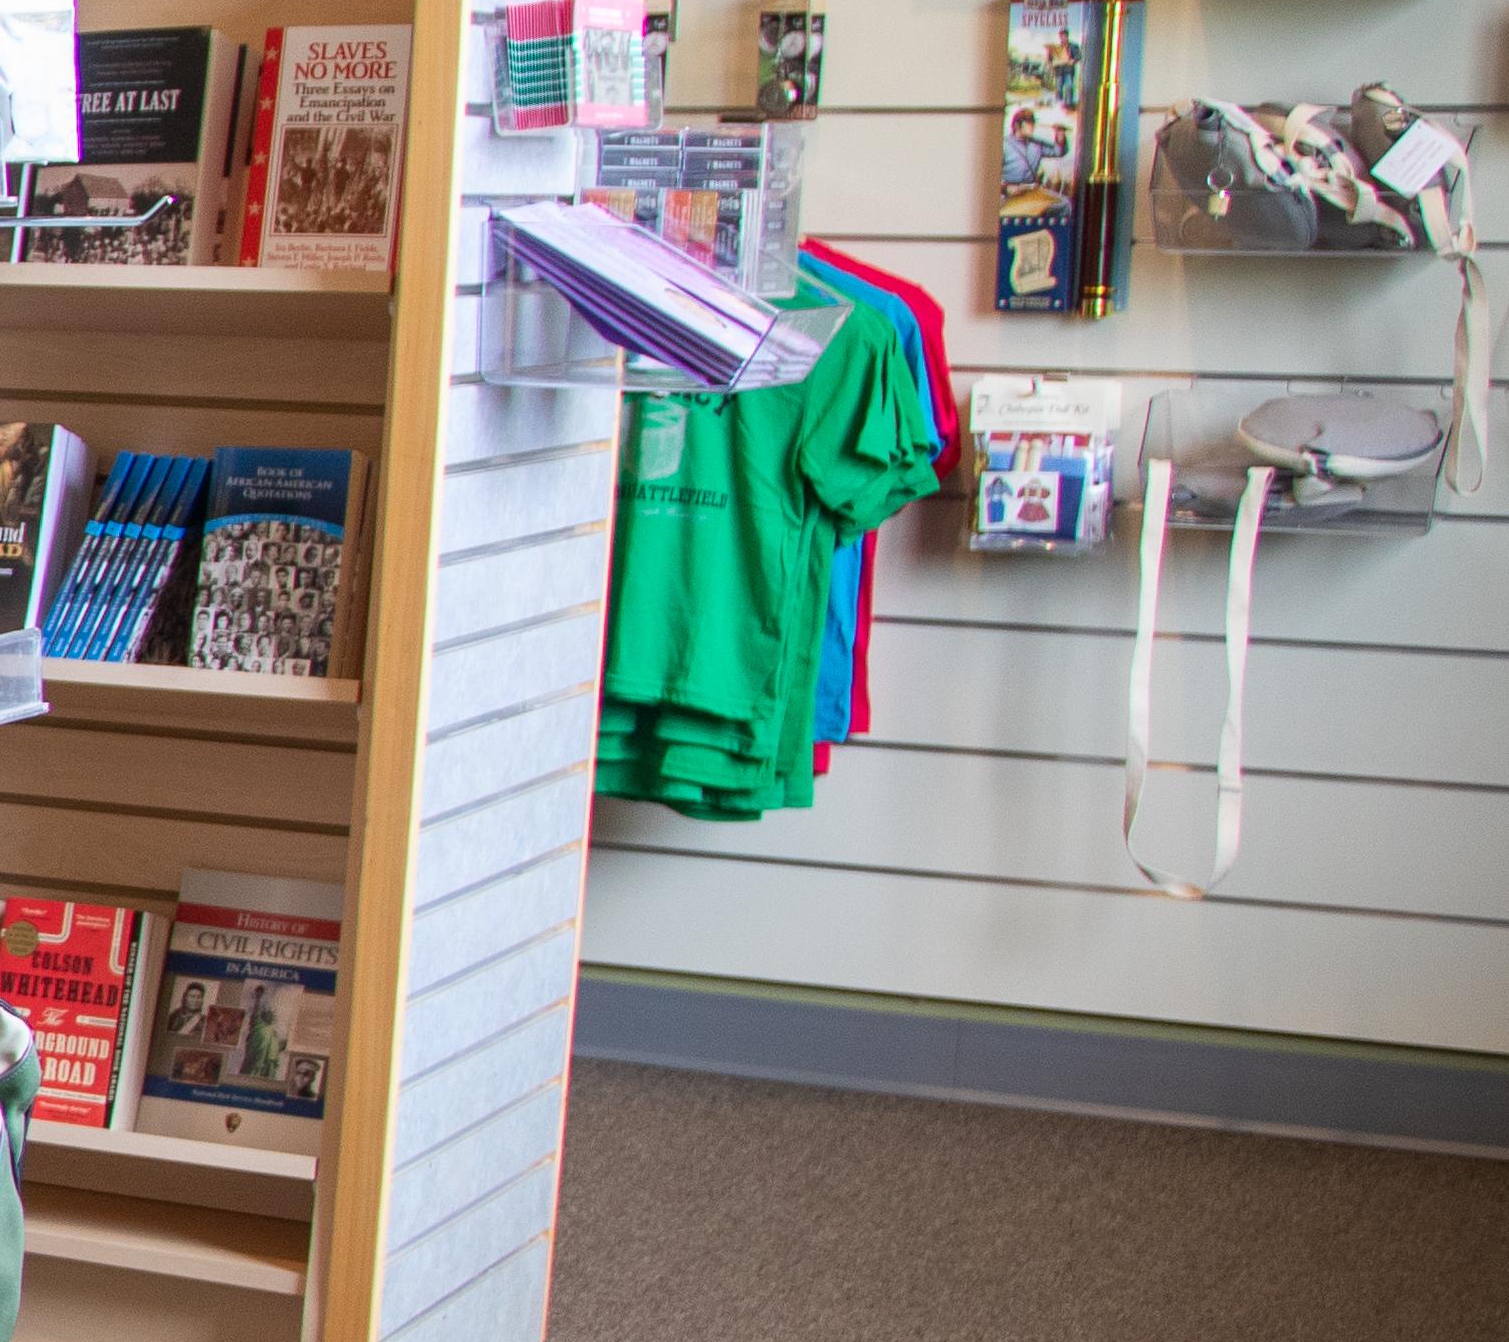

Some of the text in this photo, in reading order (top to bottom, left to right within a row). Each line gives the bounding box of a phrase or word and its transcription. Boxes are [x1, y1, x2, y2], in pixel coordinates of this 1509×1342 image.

[1022, 9, 1069, 28] SPYGLASS
[308, 41, 388, 61] SLAVES
[294, 61, 398, 80] NO MORE
[293, 82, 396, 98] Three Essays on
[76, 88, 182, 115] REE AT LAST
[298, 96, 387, 112] Emancipation
[286, 110, 397, 123] and the Civil War
[256, 466, 304, 478] BOOK OF
[242, 488, 313, 503] QUOTATIONS
[236, 912, 311, 934] HISTORY OF
[197, 931, 340, 966] CIVIL RIGHTS
[31, 950, 95, 976] COLSON
[225, 962, 301, 982] IN AMERICA
[0, 971, 120, 1008] WHITEHEAD
[37, 1006, 69, 1027] The
[35, 1031, 112, 1060] RGROUND
[43, 1056, 98, 1087] ROAD
